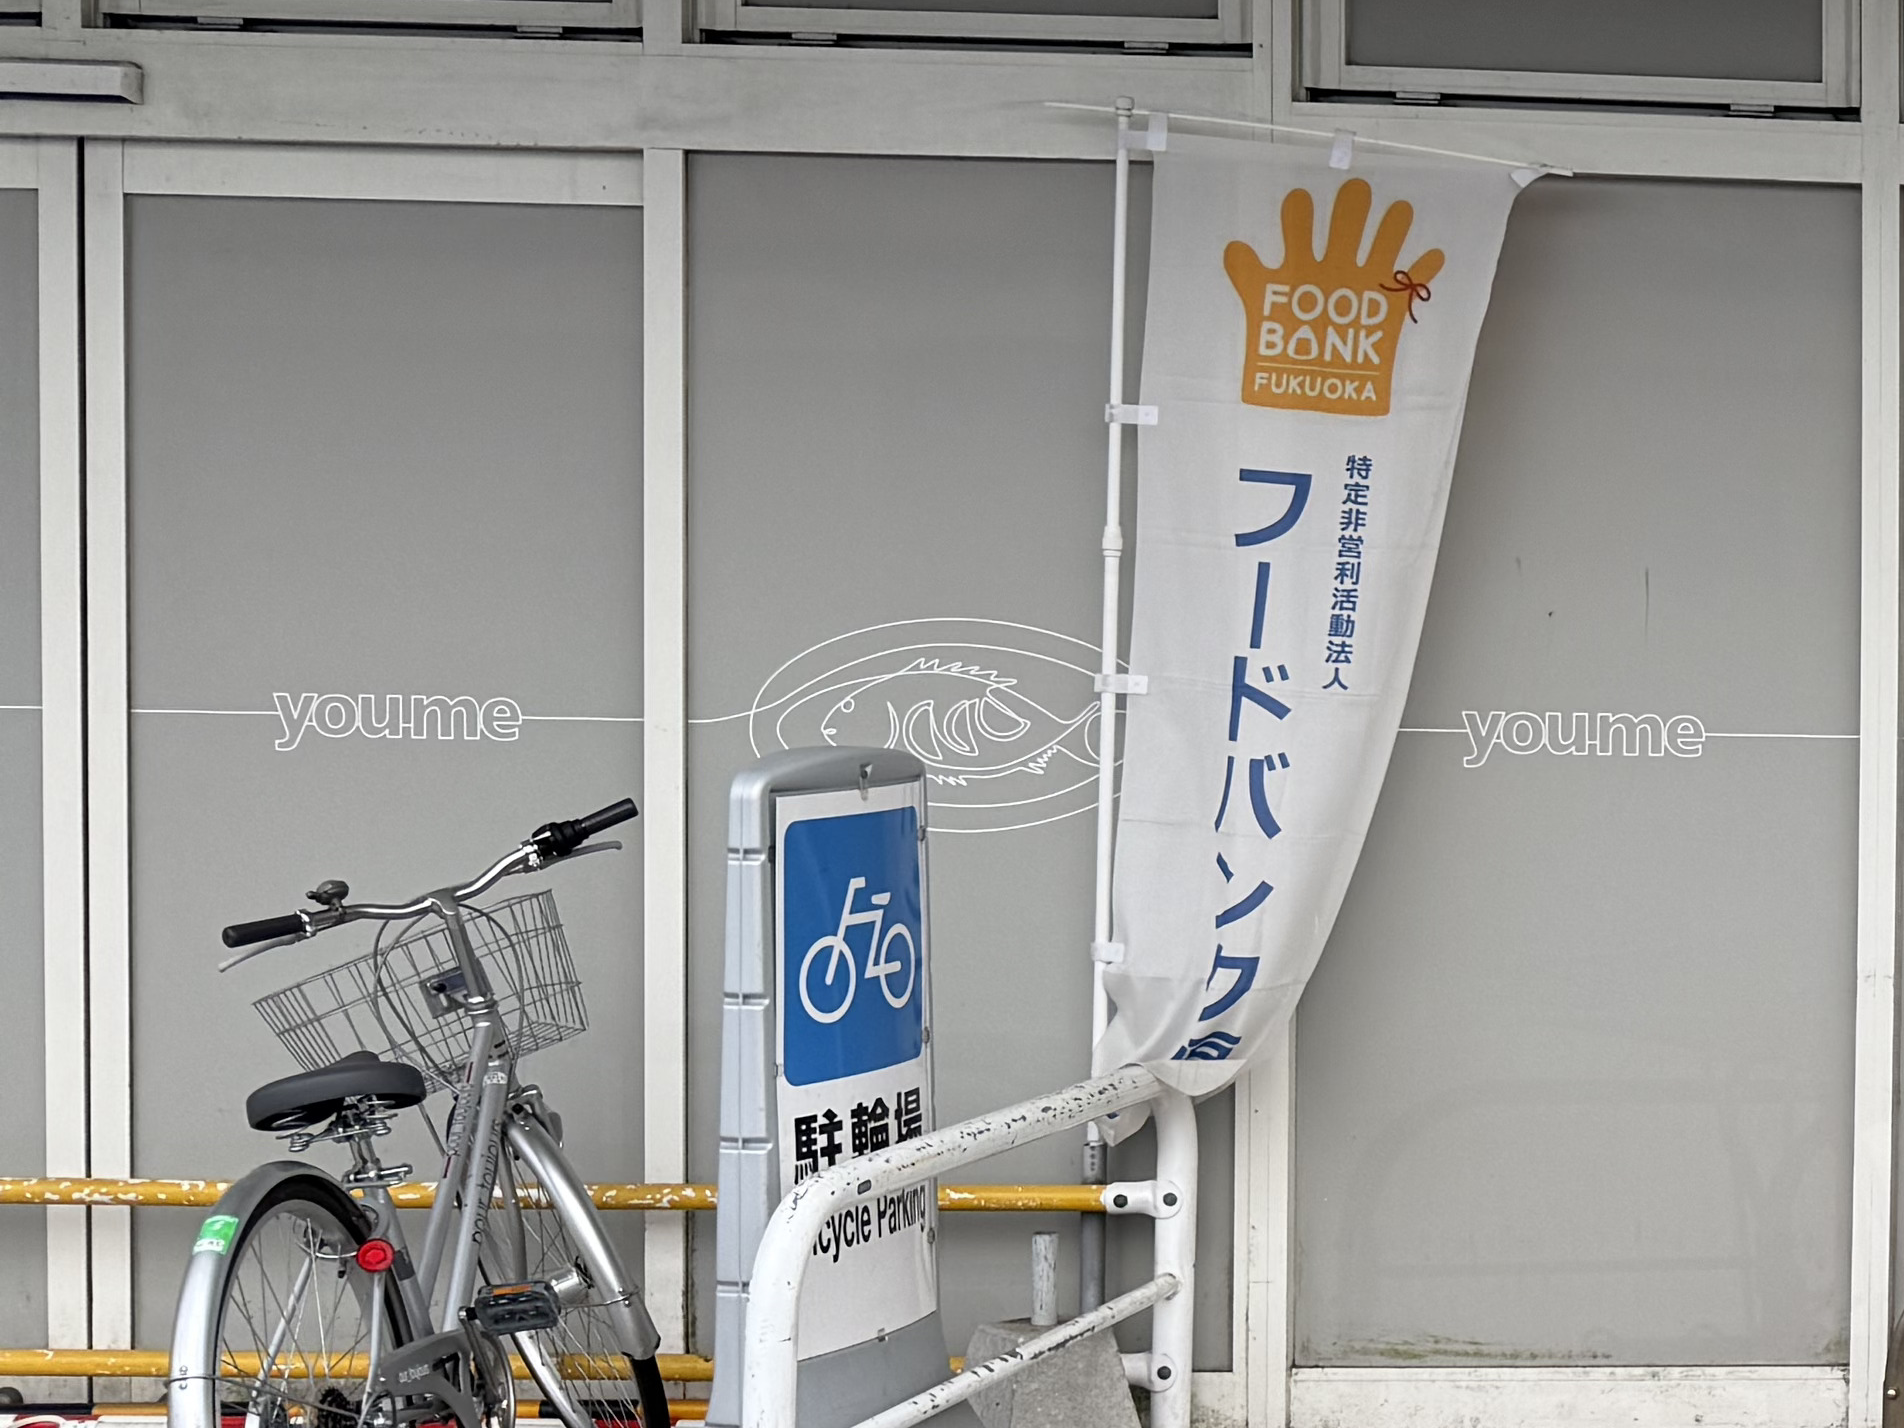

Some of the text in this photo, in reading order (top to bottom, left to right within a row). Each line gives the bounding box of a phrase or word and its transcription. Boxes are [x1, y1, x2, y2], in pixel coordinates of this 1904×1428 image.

[1263, 283, 1389, 326] FOOD
[1258, 321, 1384, 365] BANK
[1254, 372, 1377, 402] FUKUOKA
[1322, 454, 1373, 692] 特定非営利活動法人
[273, 691, 522, 751] youme
[1461, 710, 1706, 768] youme
[794, 1086, 923, 1185] 駐輪場
[812, 1184, 926, 1263] cycle Parking
